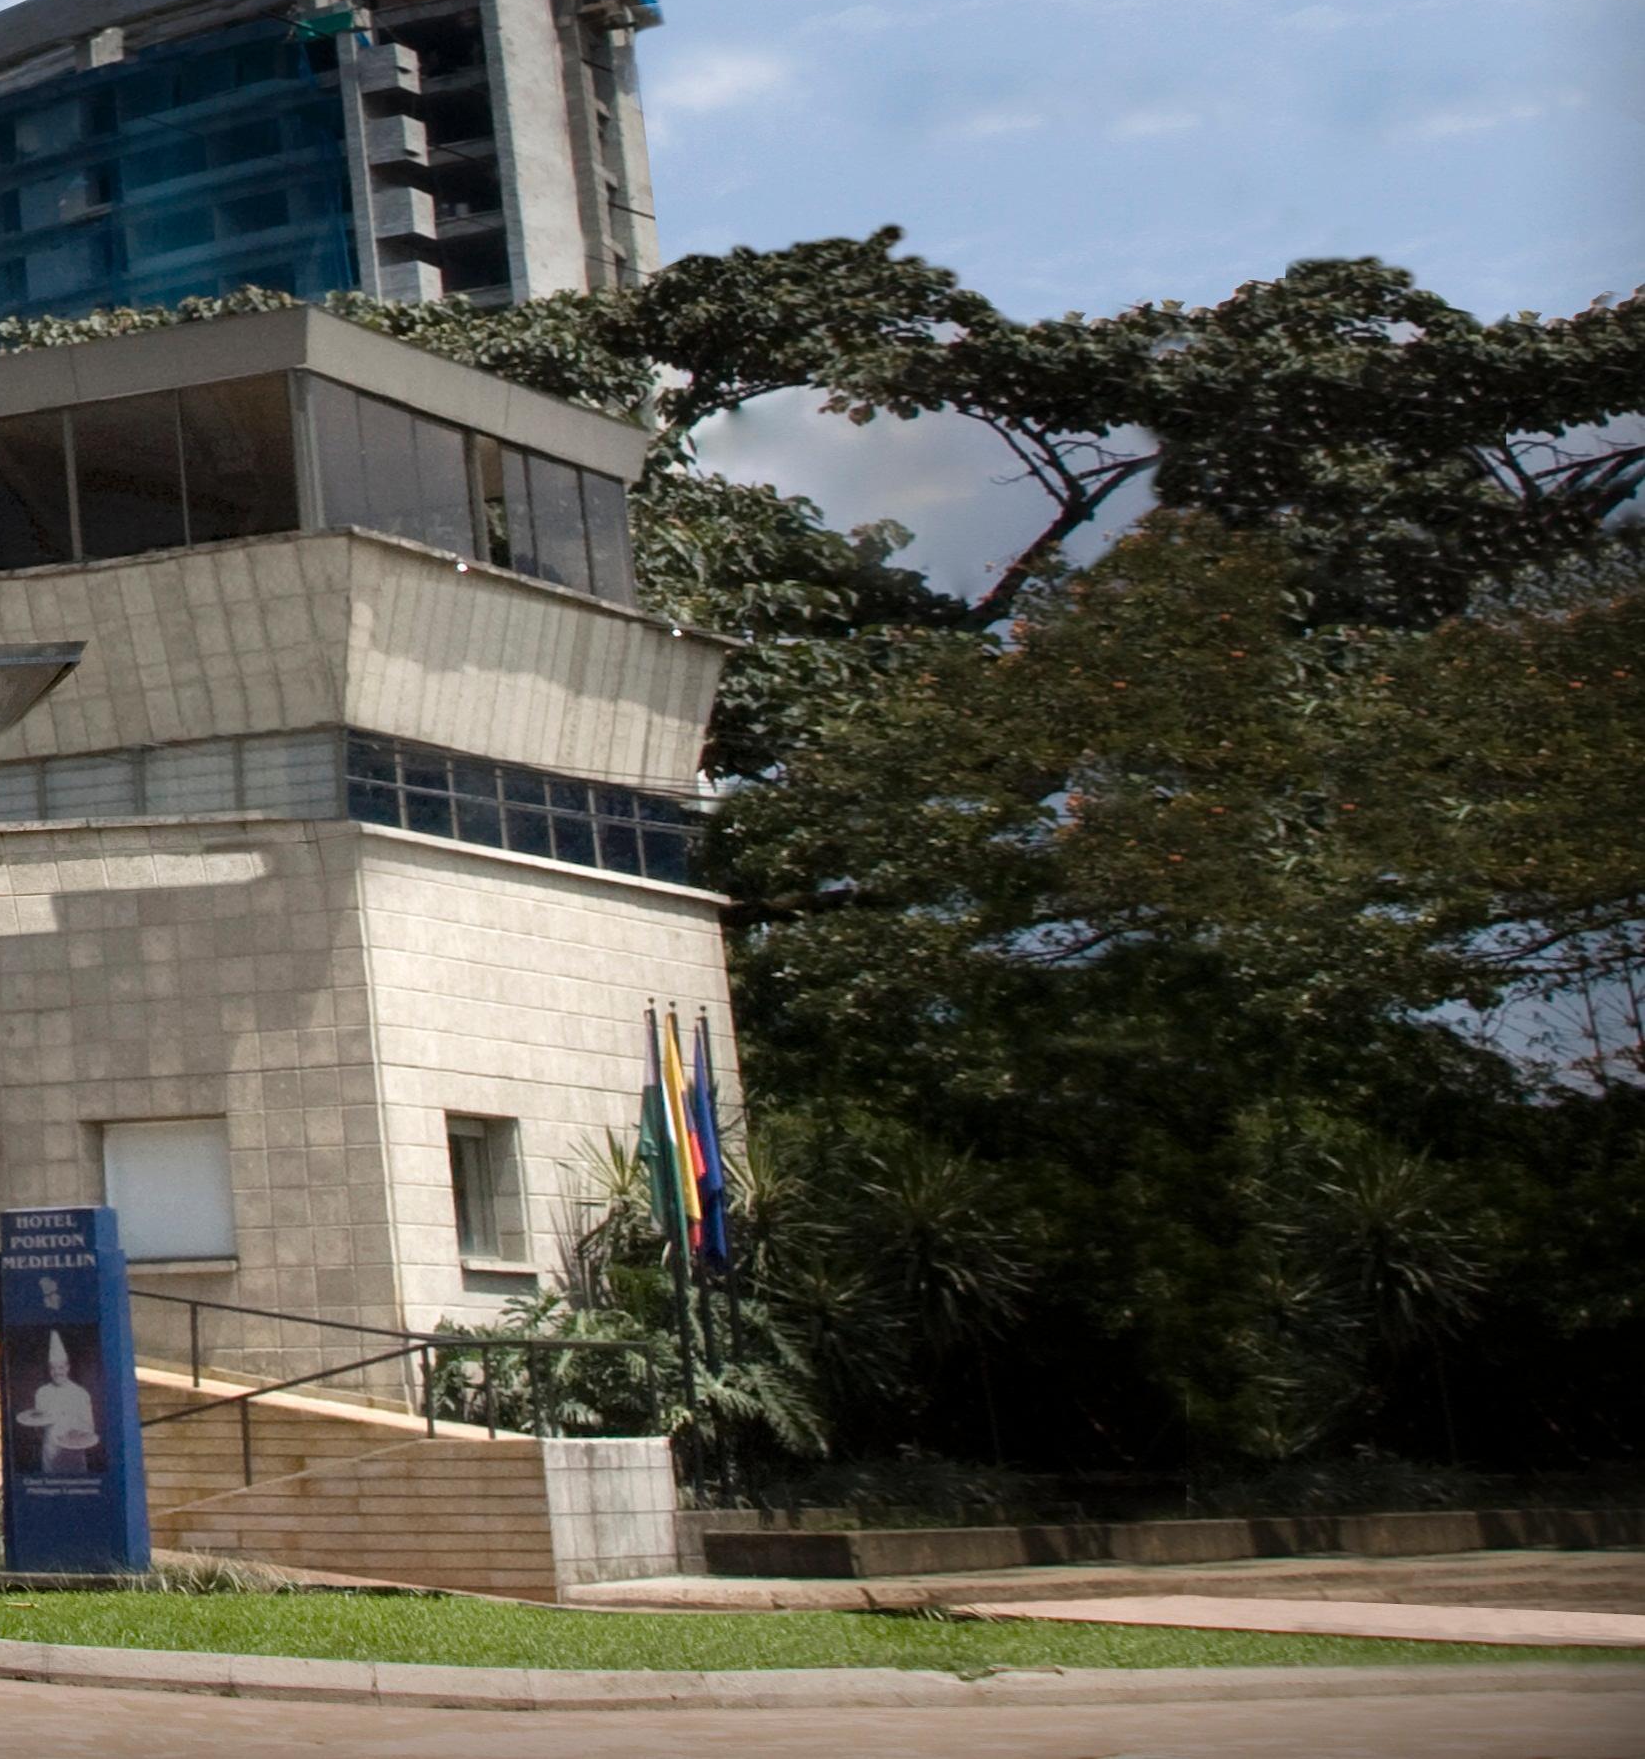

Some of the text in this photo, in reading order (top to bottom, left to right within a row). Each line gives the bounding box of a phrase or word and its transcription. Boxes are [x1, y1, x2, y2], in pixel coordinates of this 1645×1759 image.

[14, 1213, 78, 1229] HOTEL
[9, 1233, 86, 1250] PORTON
[1, 1253, 97, 1270] MEDELLIN
